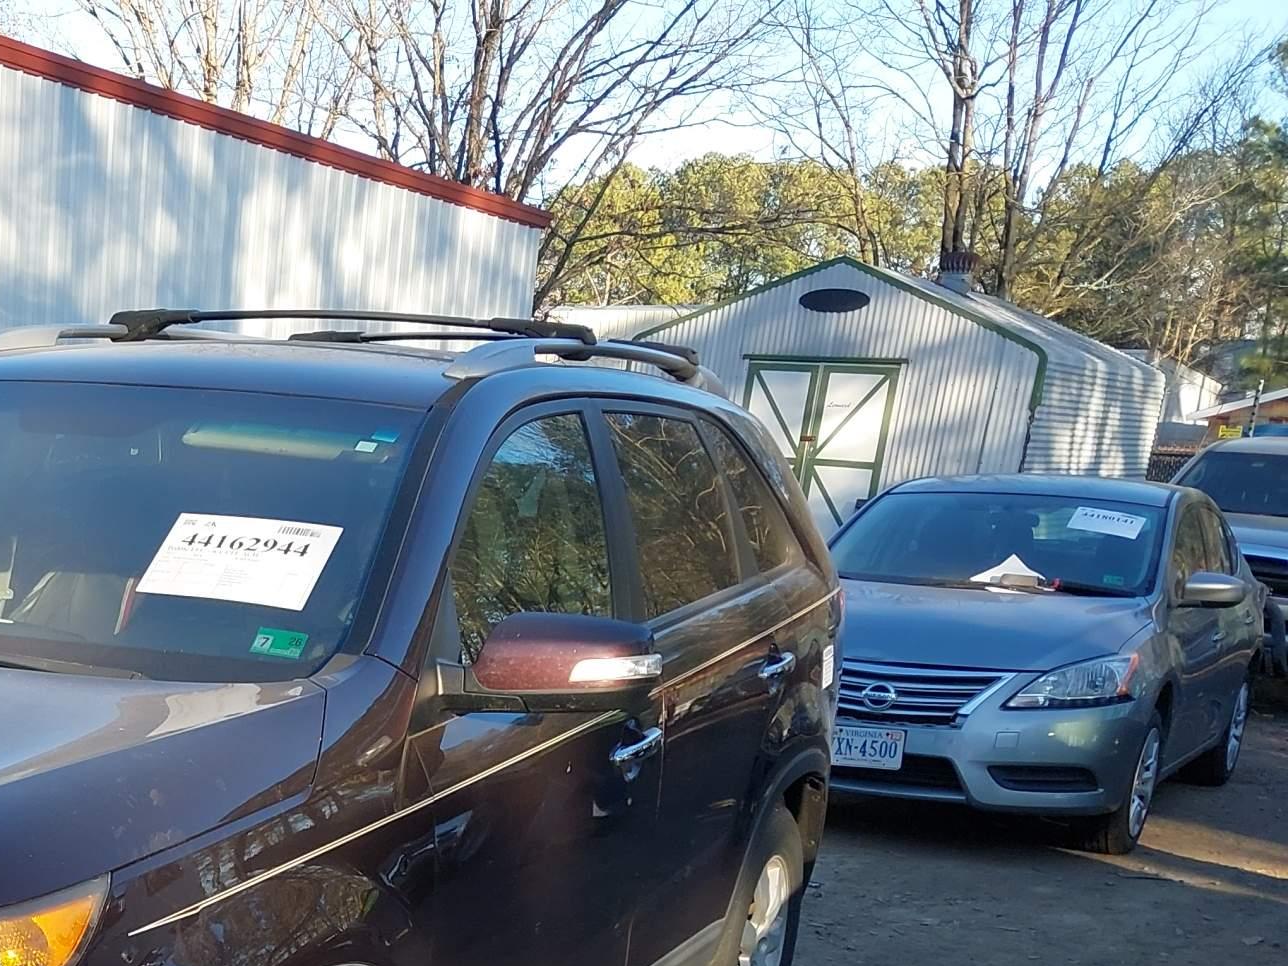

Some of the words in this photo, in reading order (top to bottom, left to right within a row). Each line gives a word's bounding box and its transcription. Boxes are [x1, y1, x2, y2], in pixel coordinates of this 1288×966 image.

[181, 532, 312, 557] 44162944
[260, 636, 270, 647] 7
[845, 729, 883, 739] VIRGINIA
